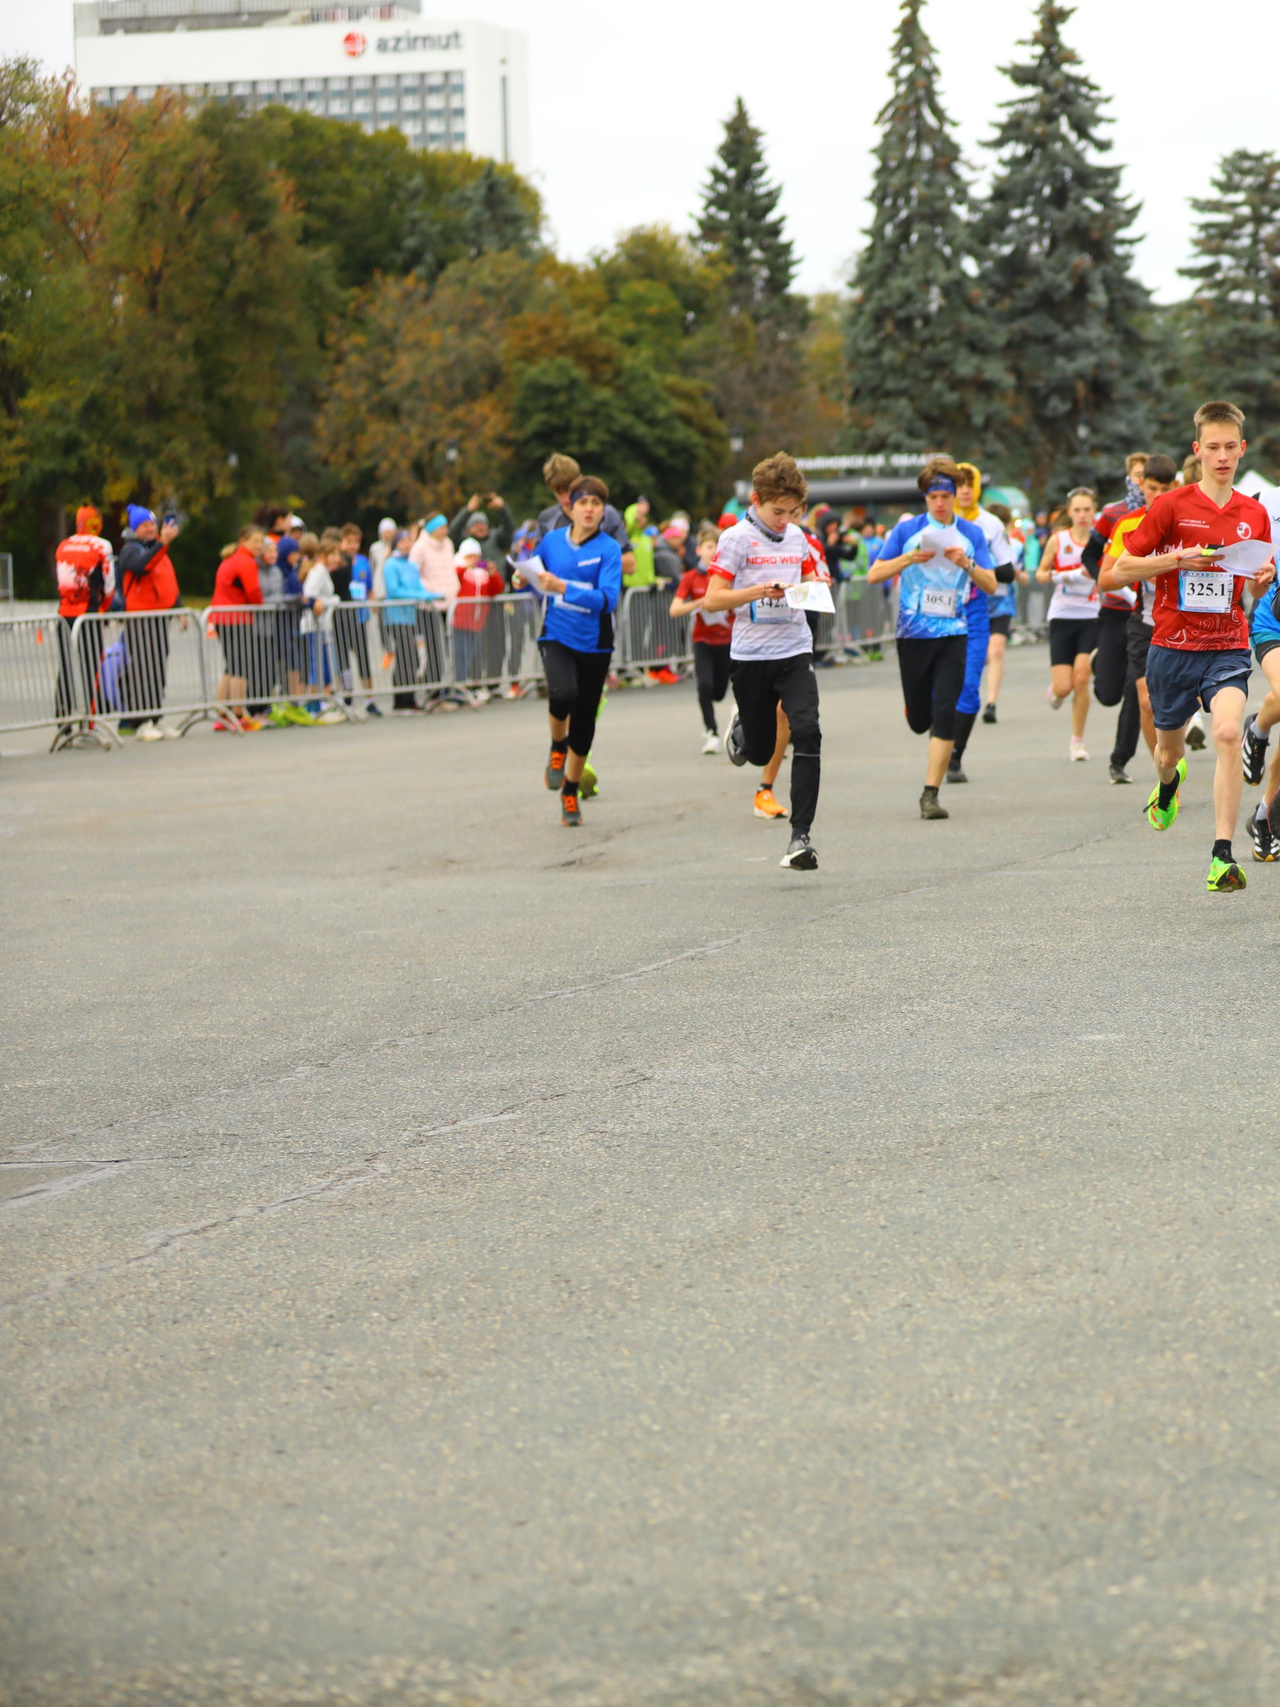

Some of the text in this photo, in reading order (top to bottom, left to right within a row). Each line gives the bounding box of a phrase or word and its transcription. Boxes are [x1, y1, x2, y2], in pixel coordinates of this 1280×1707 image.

[377, 30, 462, 53] azimut
[746, 556, 803, 565] NORD WES
[1187, 582, 1226, 597] 325.1
[757, 598, 790, 609] 342.
[926, 593, 953, 607] 305.1
